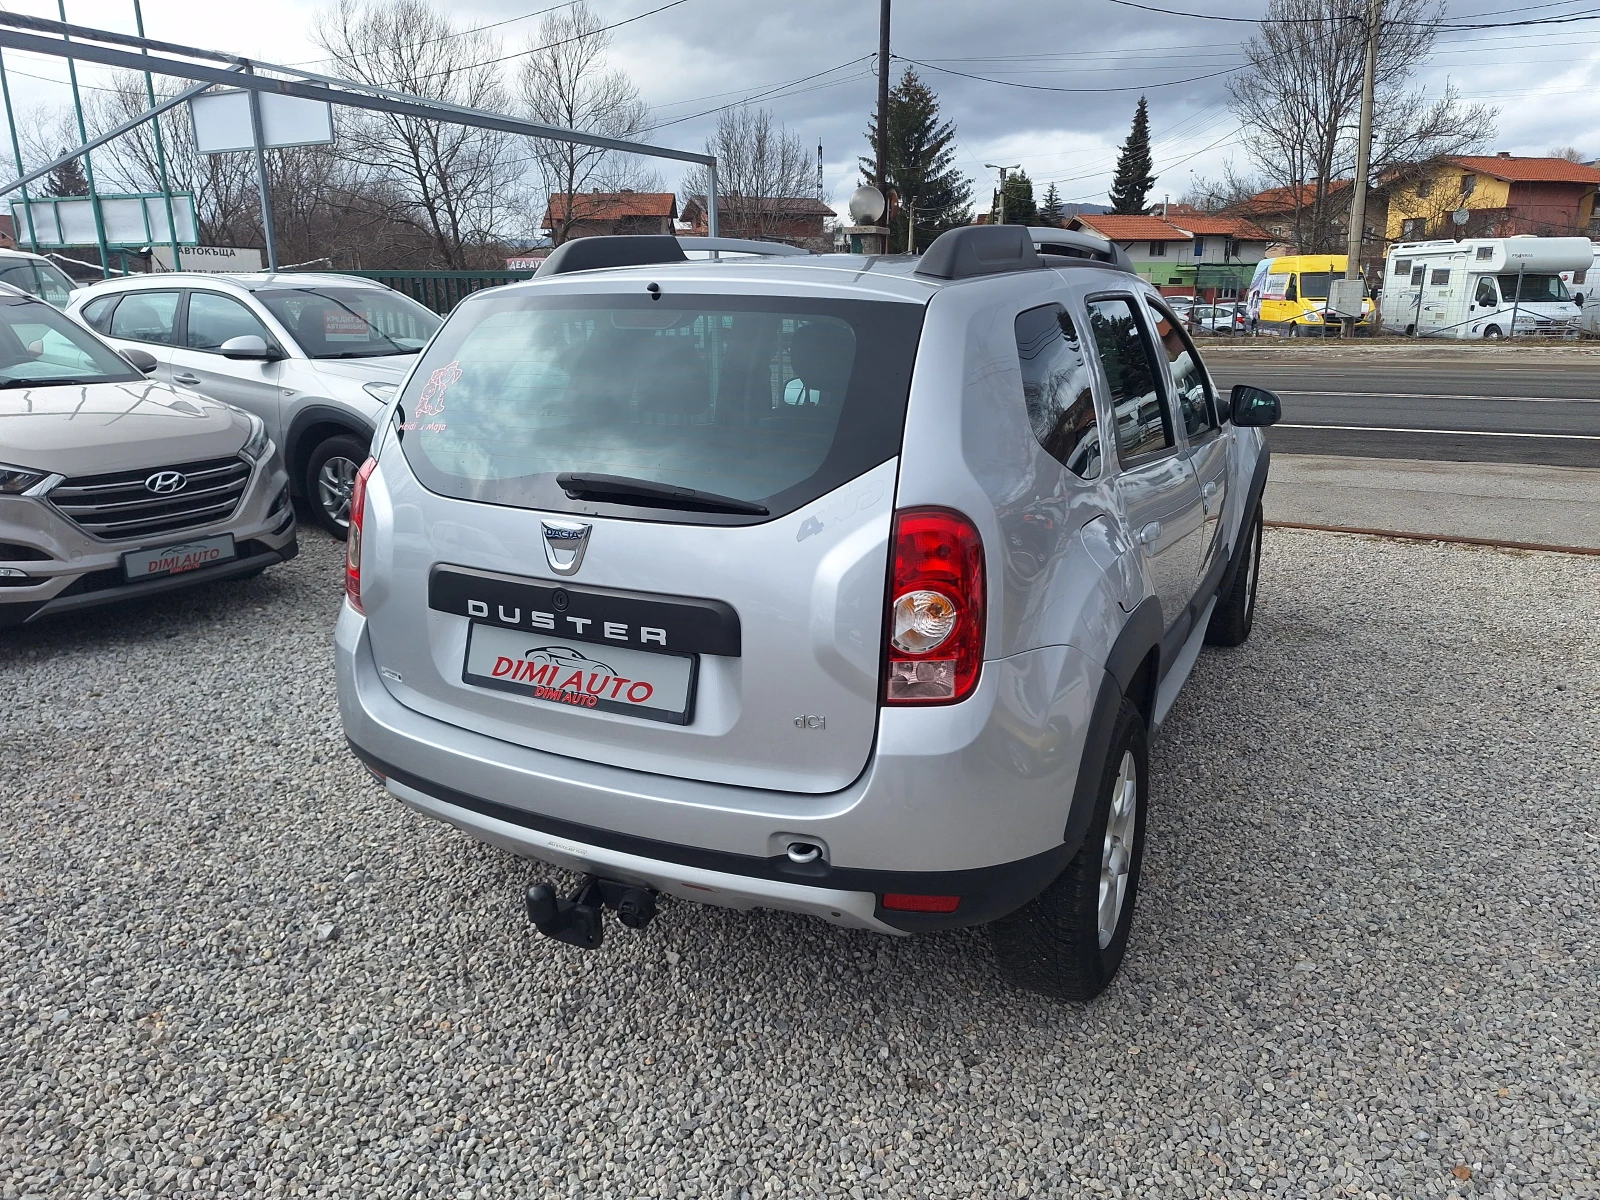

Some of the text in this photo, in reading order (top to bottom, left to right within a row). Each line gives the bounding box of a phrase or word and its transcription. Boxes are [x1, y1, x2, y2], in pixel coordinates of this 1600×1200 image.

[179, 248, 236, 257] АВТОКЪЩА
[426, 422, 447, 434] Maja
[546, 529, 580, 539] DACIA
[148, 548, 220, 572] DIMI AUTO
[467, 599, 667, 645] DUSTER
[491, 656, 654, 703] DIMI AUTO
[535, 685, 598, 707] DIMI AUTO
